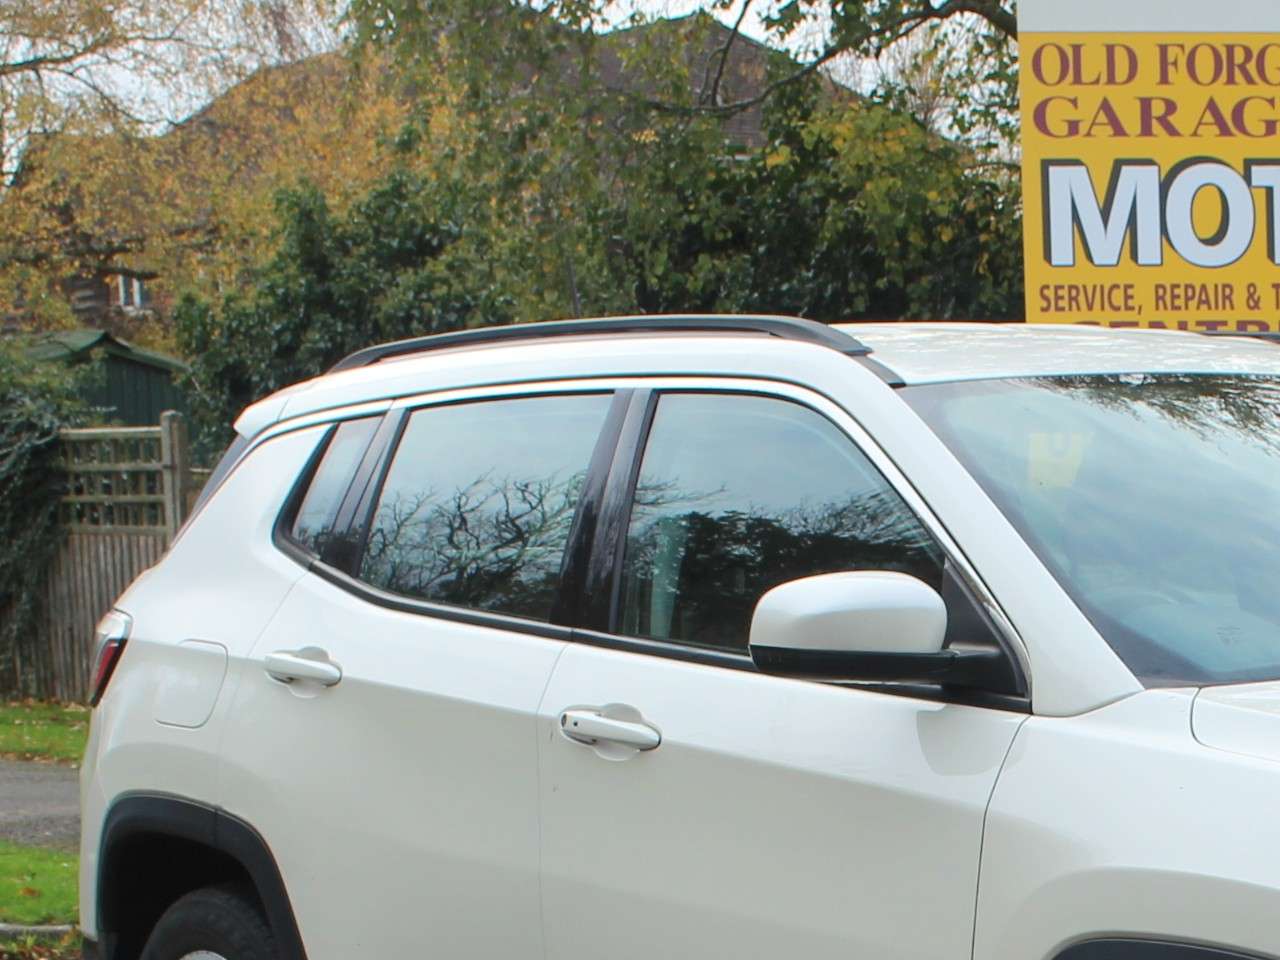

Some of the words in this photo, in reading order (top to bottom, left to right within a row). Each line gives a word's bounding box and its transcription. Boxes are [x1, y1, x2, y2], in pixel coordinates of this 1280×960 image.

[1031, 42, 1139, 87] OLD
[1038, 283, 1143, 316] SERVICE,
[1154, 282, 1235, 312] REPAIR
[1246, 282, 1262, 311] &
